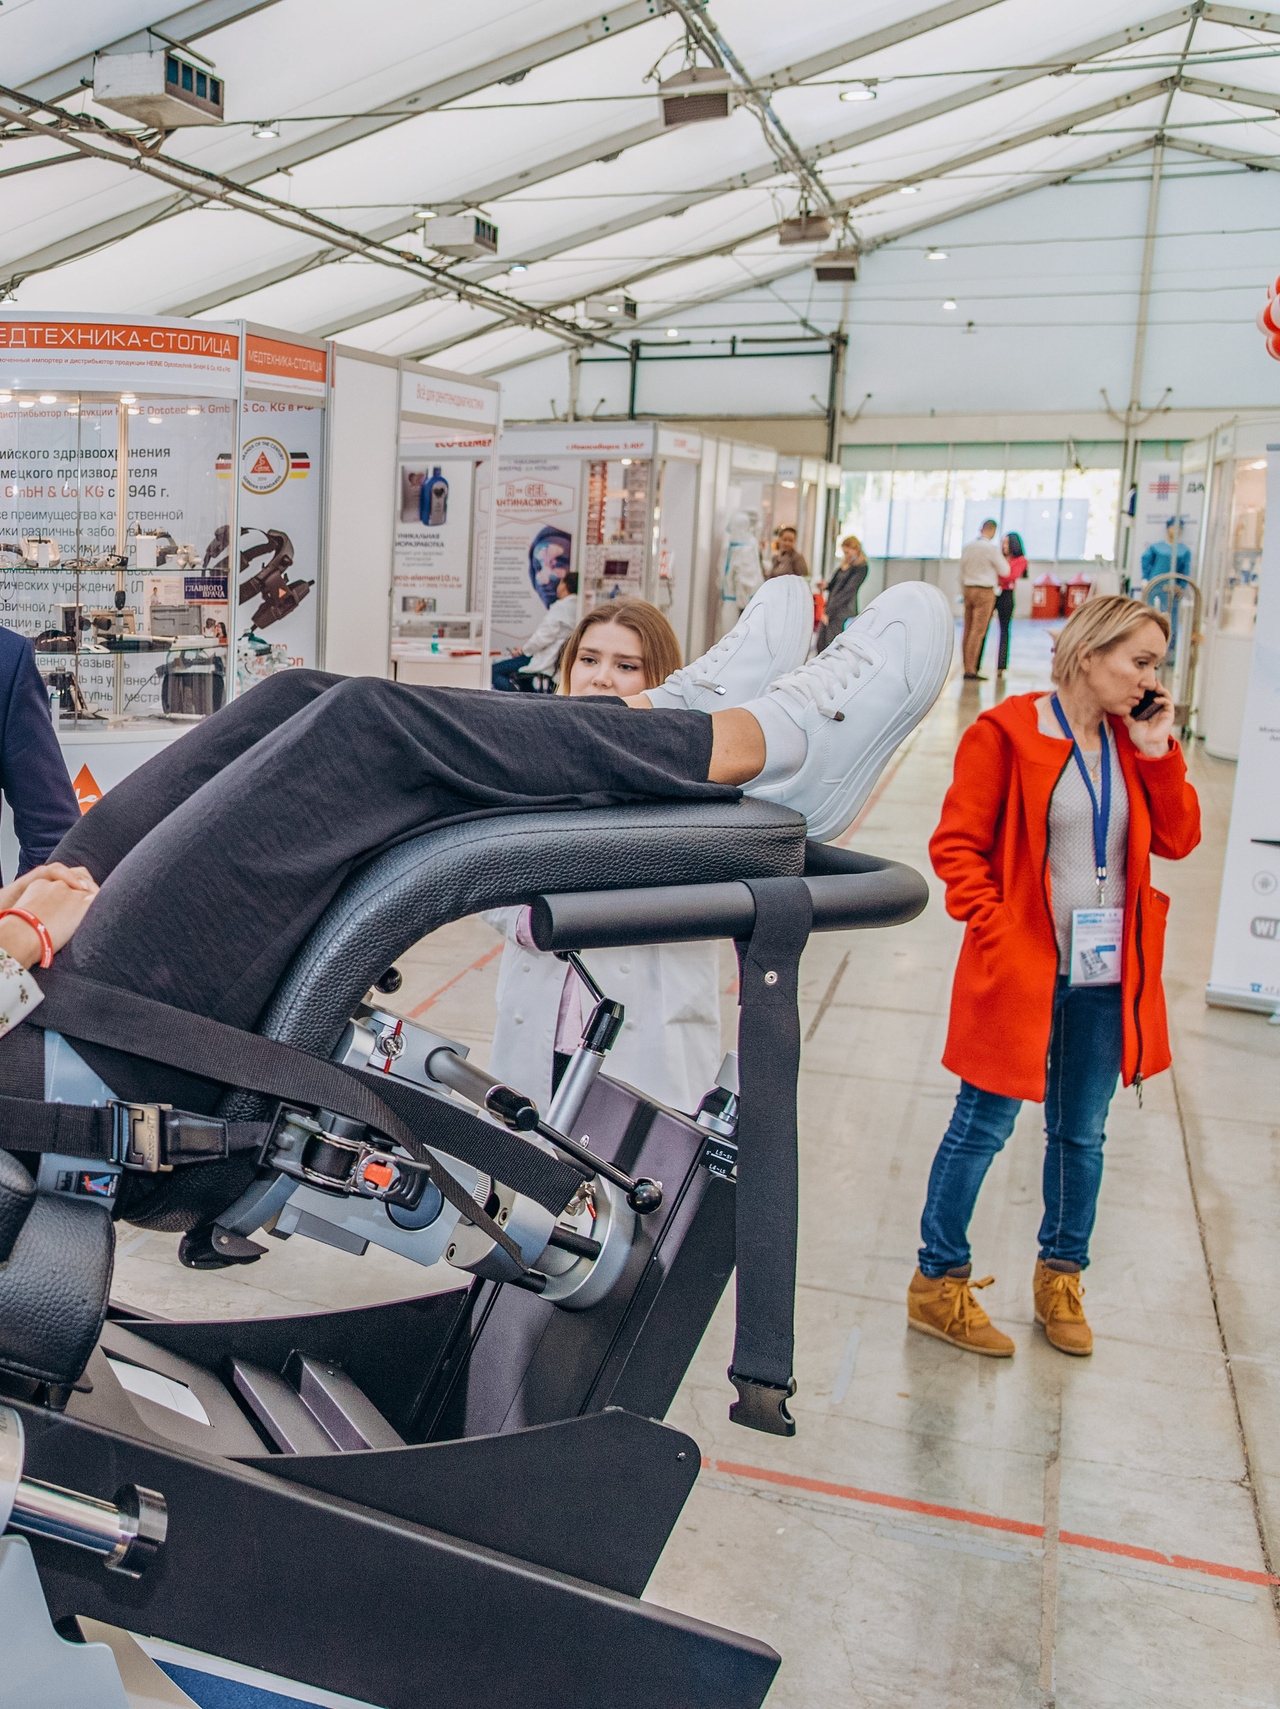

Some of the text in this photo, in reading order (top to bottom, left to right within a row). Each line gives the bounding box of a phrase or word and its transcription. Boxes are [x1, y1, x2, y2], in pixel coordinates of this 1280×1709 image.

[248, 350, 322, 374] МЕДТЕХНИКА-СТОЛИЦА
[57, 468, 158, 481] производтеля
[48, 486, 56, 498] &
[85, 486, 104, 498] KG
[128, 485, 156, 498] 946
[160, 488, 169, 498] г.
[11, 511, 97, 522] преимущества
[100, 510, 184, 520] качственной
[91, 675, 104, 684] на
